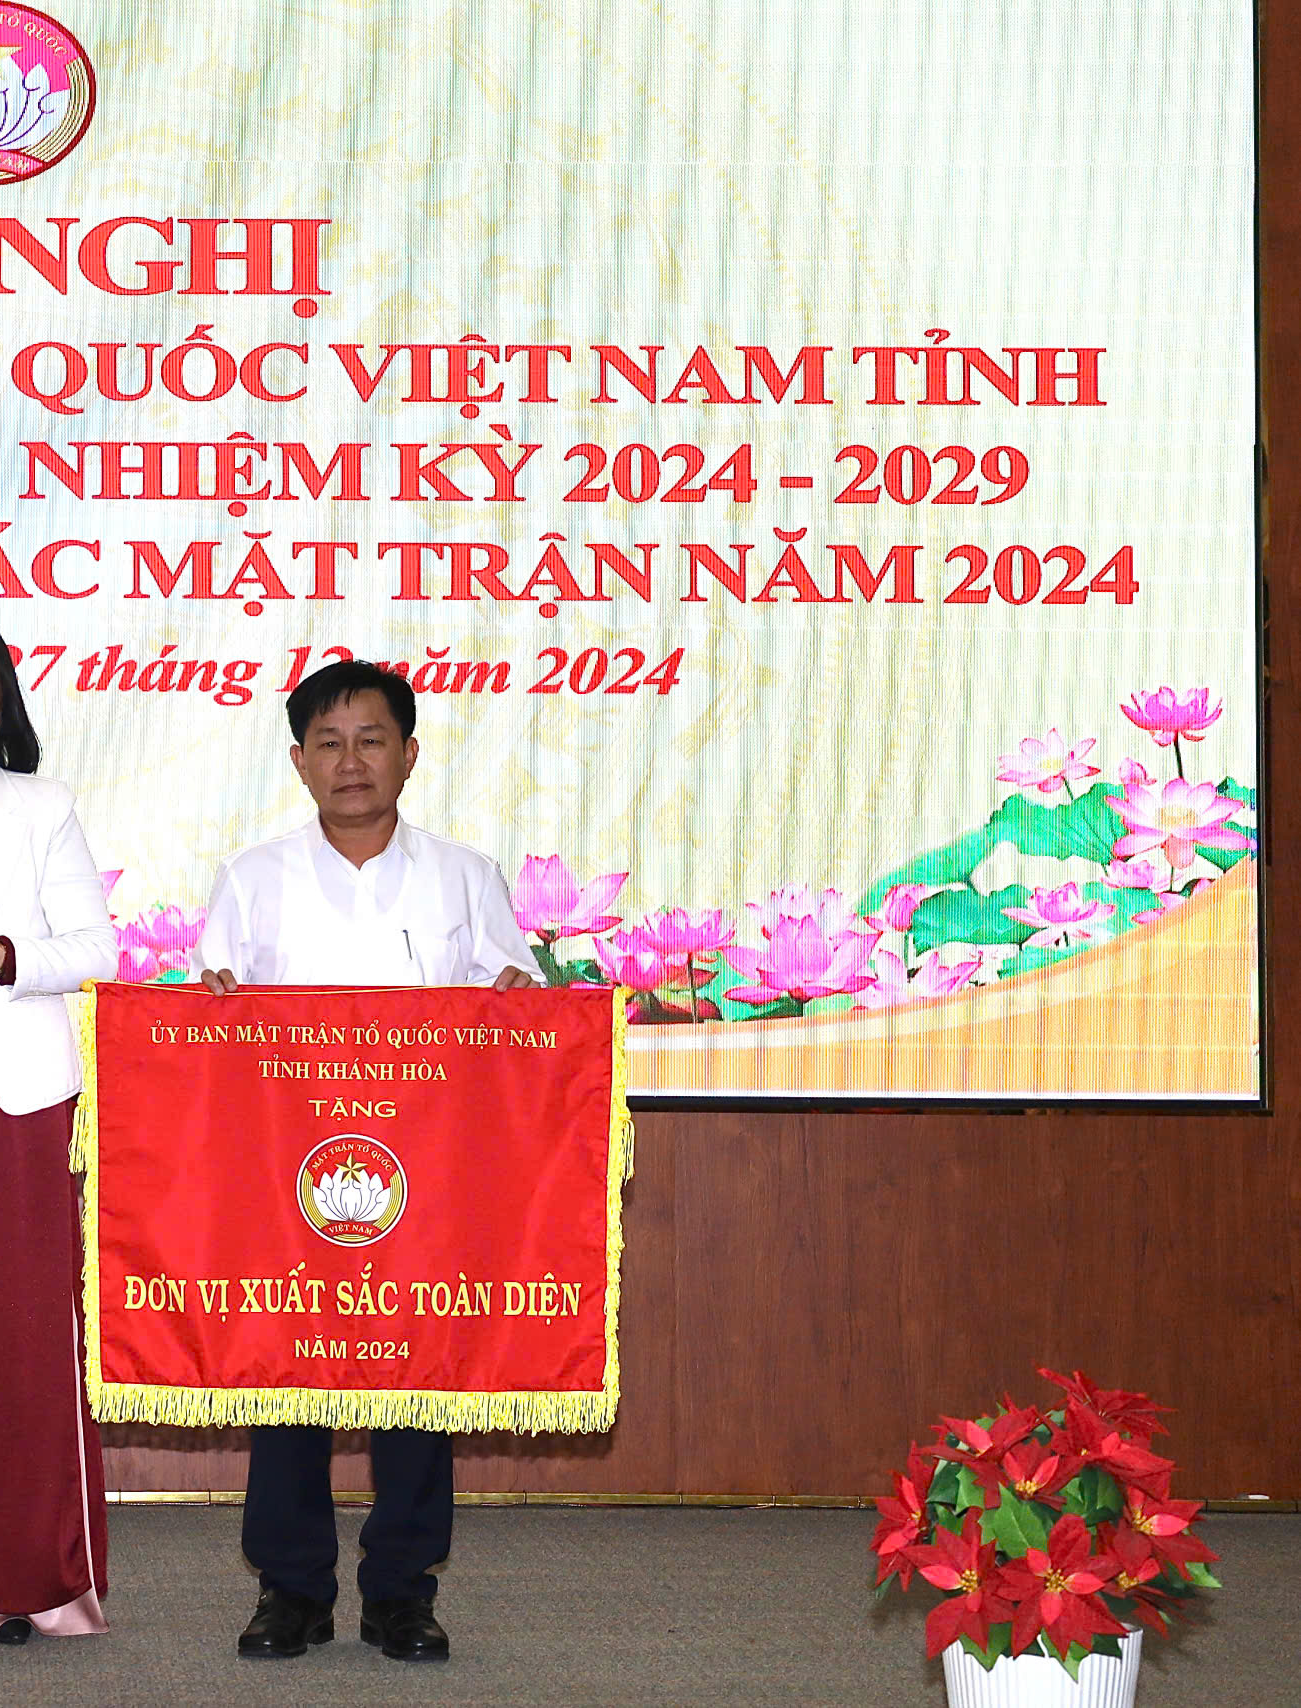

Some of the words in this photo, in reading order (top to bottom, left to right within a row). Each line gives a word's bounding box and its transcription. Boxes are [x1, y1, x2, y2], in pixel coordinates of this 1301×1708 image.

[11, 324, 308, 415] QUỐC
[329, 334, 571, 420] VIỆT
[590, 345, 833, 404] NAM
[853, 328, 1107, 406] TỈNH
[19, 432, 371, 517] NHIỆM
[390, 423, 542, 503] KỲ
[563, 443, 757, 504] 2024
[834, 445, 1029, 505] 2029
[123, 531, 358, 616] MẶT
[379, 532, 659, 618] TRẬN
[680, 528, 923, 603] NĂM
[944, 544, 1139, 605] 2024
[76, 644, 262, 706] tháng
[527, 648, 685, 695] 2024
[150, 1019, 180, 1044] ỦY
[186, 1026, 229, 1043] BAN
[235, 1020, 281, 1046] MẶT
[286, 1022, 346, 1048] TRẬN
[351, 1019, 380, 1045] TỔ
[386, 1019, 447, 1049] QUỐC
[453, 1023, 503, 1050] VIỆT
[509, 1029, 558, 1049] NAM
[258, 1053, 311, 1079] TỈNH
[317, 1058, 395, 1081] KHÁNH
[401, 1058, 448, 1081] HÒA
[308, 1096, 397, 1121] TẶNG
[328, 1224, 350, 1234] VIỆT
[352, 1225, 373, 1235] NAM
[124, 1272, 187, 1313] ĐƠN
[196, 1279, 230, 1322] VỊ
[239, 1261, 326, 1314] XUẤT
[336, 1262, 399, 1316] SẮC
[409, 1270, 493, 1317] TOÀN
[503, 1272, 582, 1325] DIỆN
[294, 1333, 348, 1360] NĂM
[356, 1341, 410, 1360] 2024
